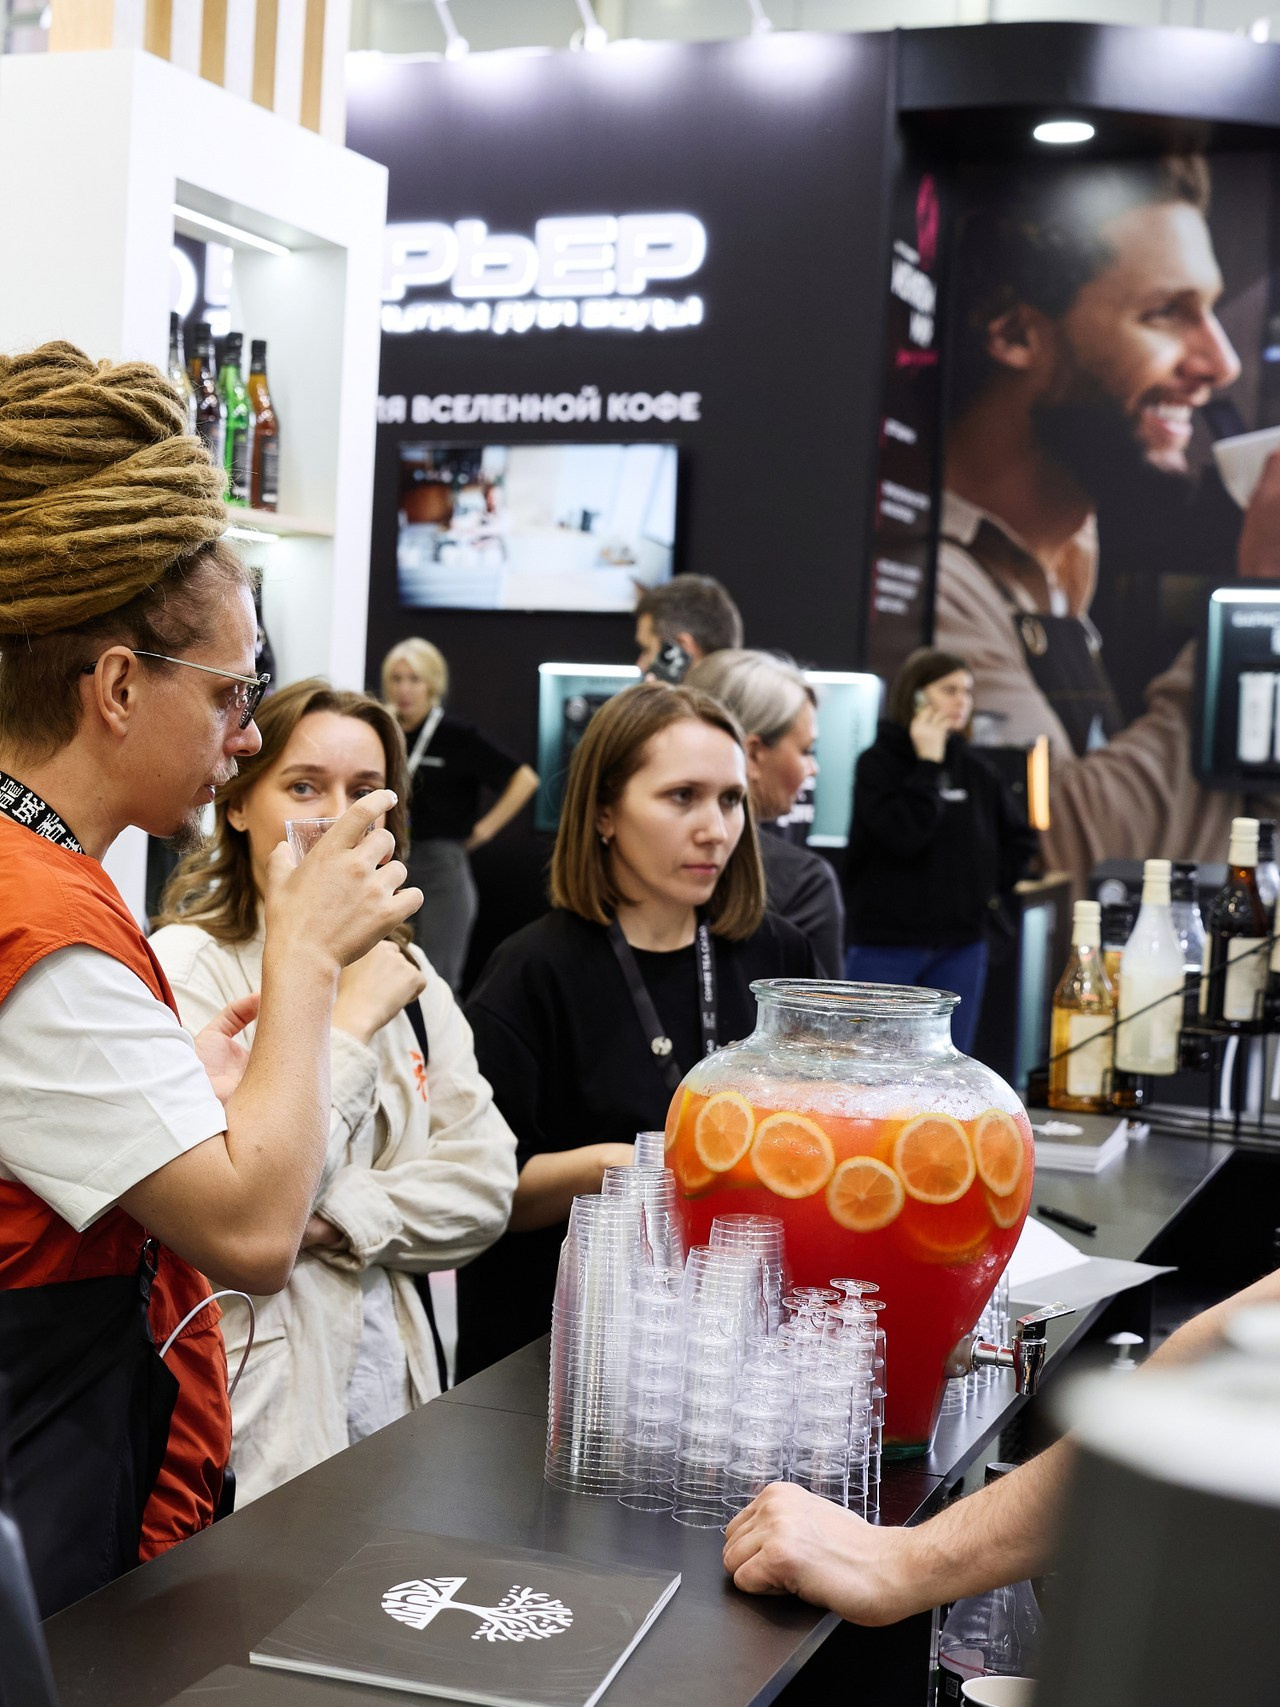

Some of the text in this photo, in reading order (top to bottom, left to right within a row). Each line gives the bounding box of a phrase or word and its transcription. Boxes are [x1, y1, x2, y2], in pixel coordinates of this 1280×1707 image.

[411, 385, 602, 424] ВСЕЛЕННОЙ
[606, 391, 702, 423] КОФЕ
[702, 953, 711, 970] TEA
[703, 971, 713, 1002] COFFEE
